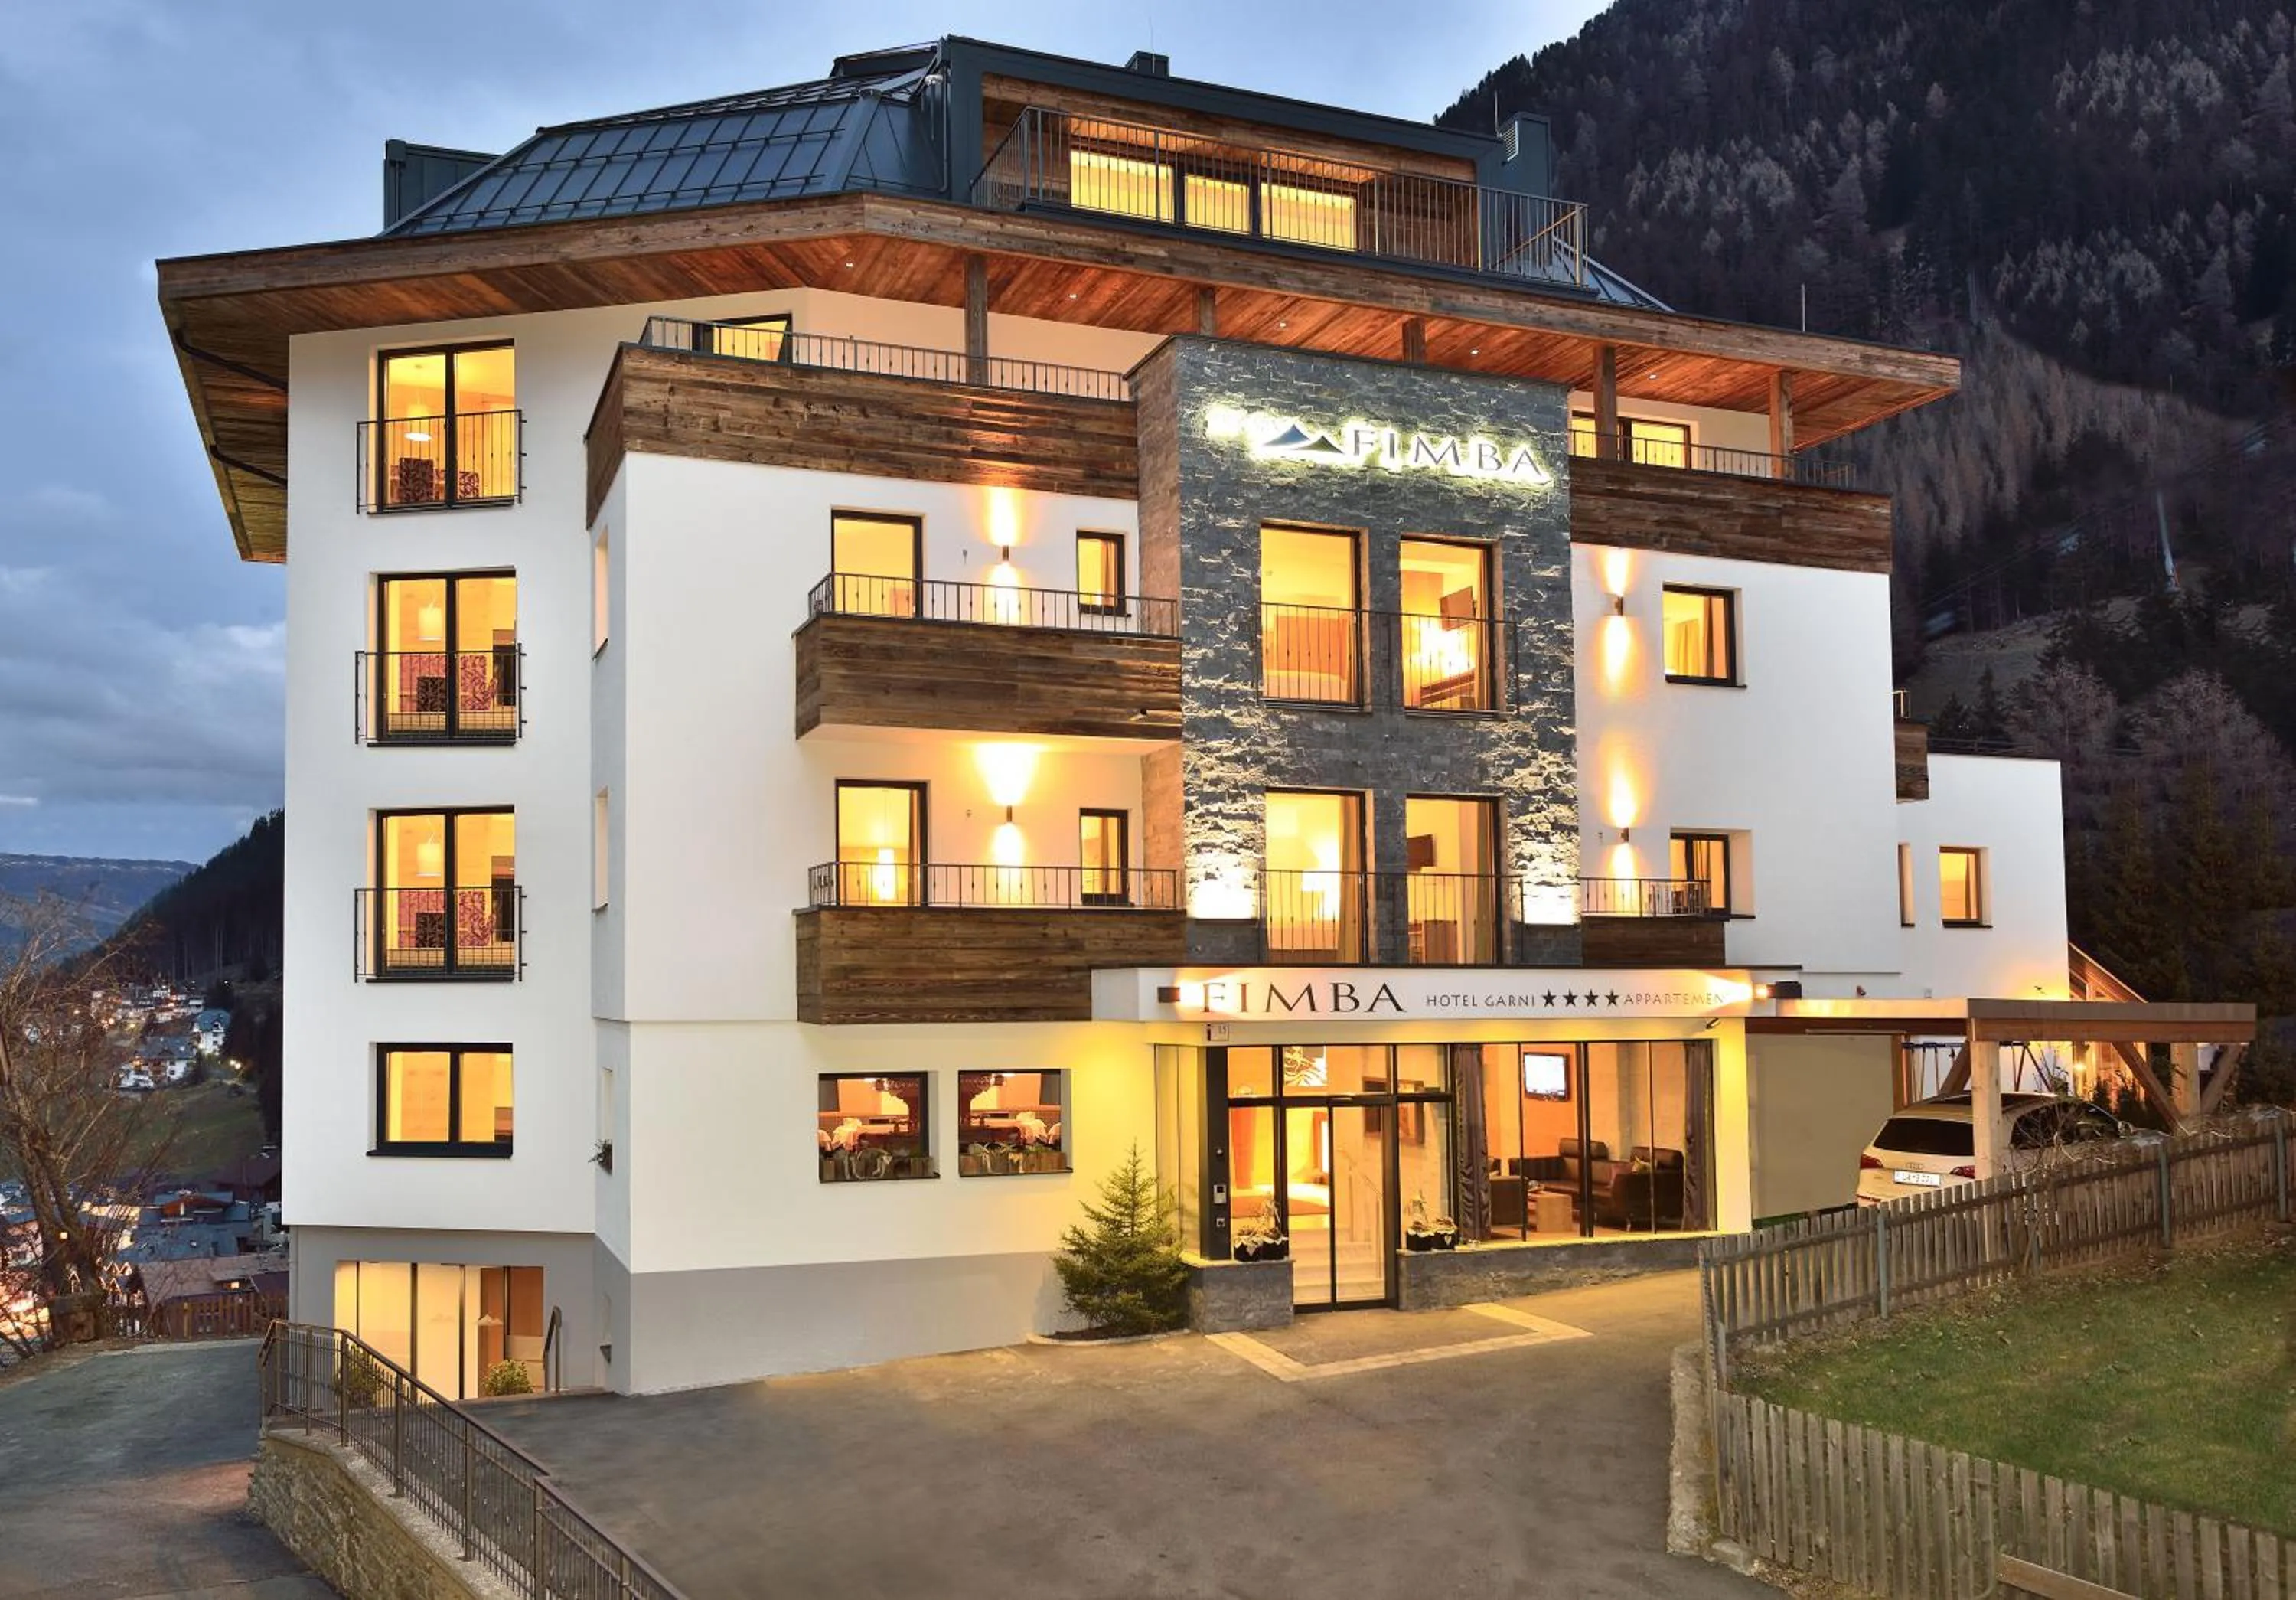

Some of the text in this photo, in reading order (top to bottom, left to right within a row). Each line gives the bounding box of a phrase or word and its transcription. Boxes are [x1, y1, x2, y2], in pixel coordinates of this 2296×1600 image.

[1352, 429, 1542, 476] FIMBA
[1202, 982, 1407, 1013] FIMBA
[1426, 995, 1478, 1007] HOTEL
[1484, 994, 1535, 1007] GARNI
